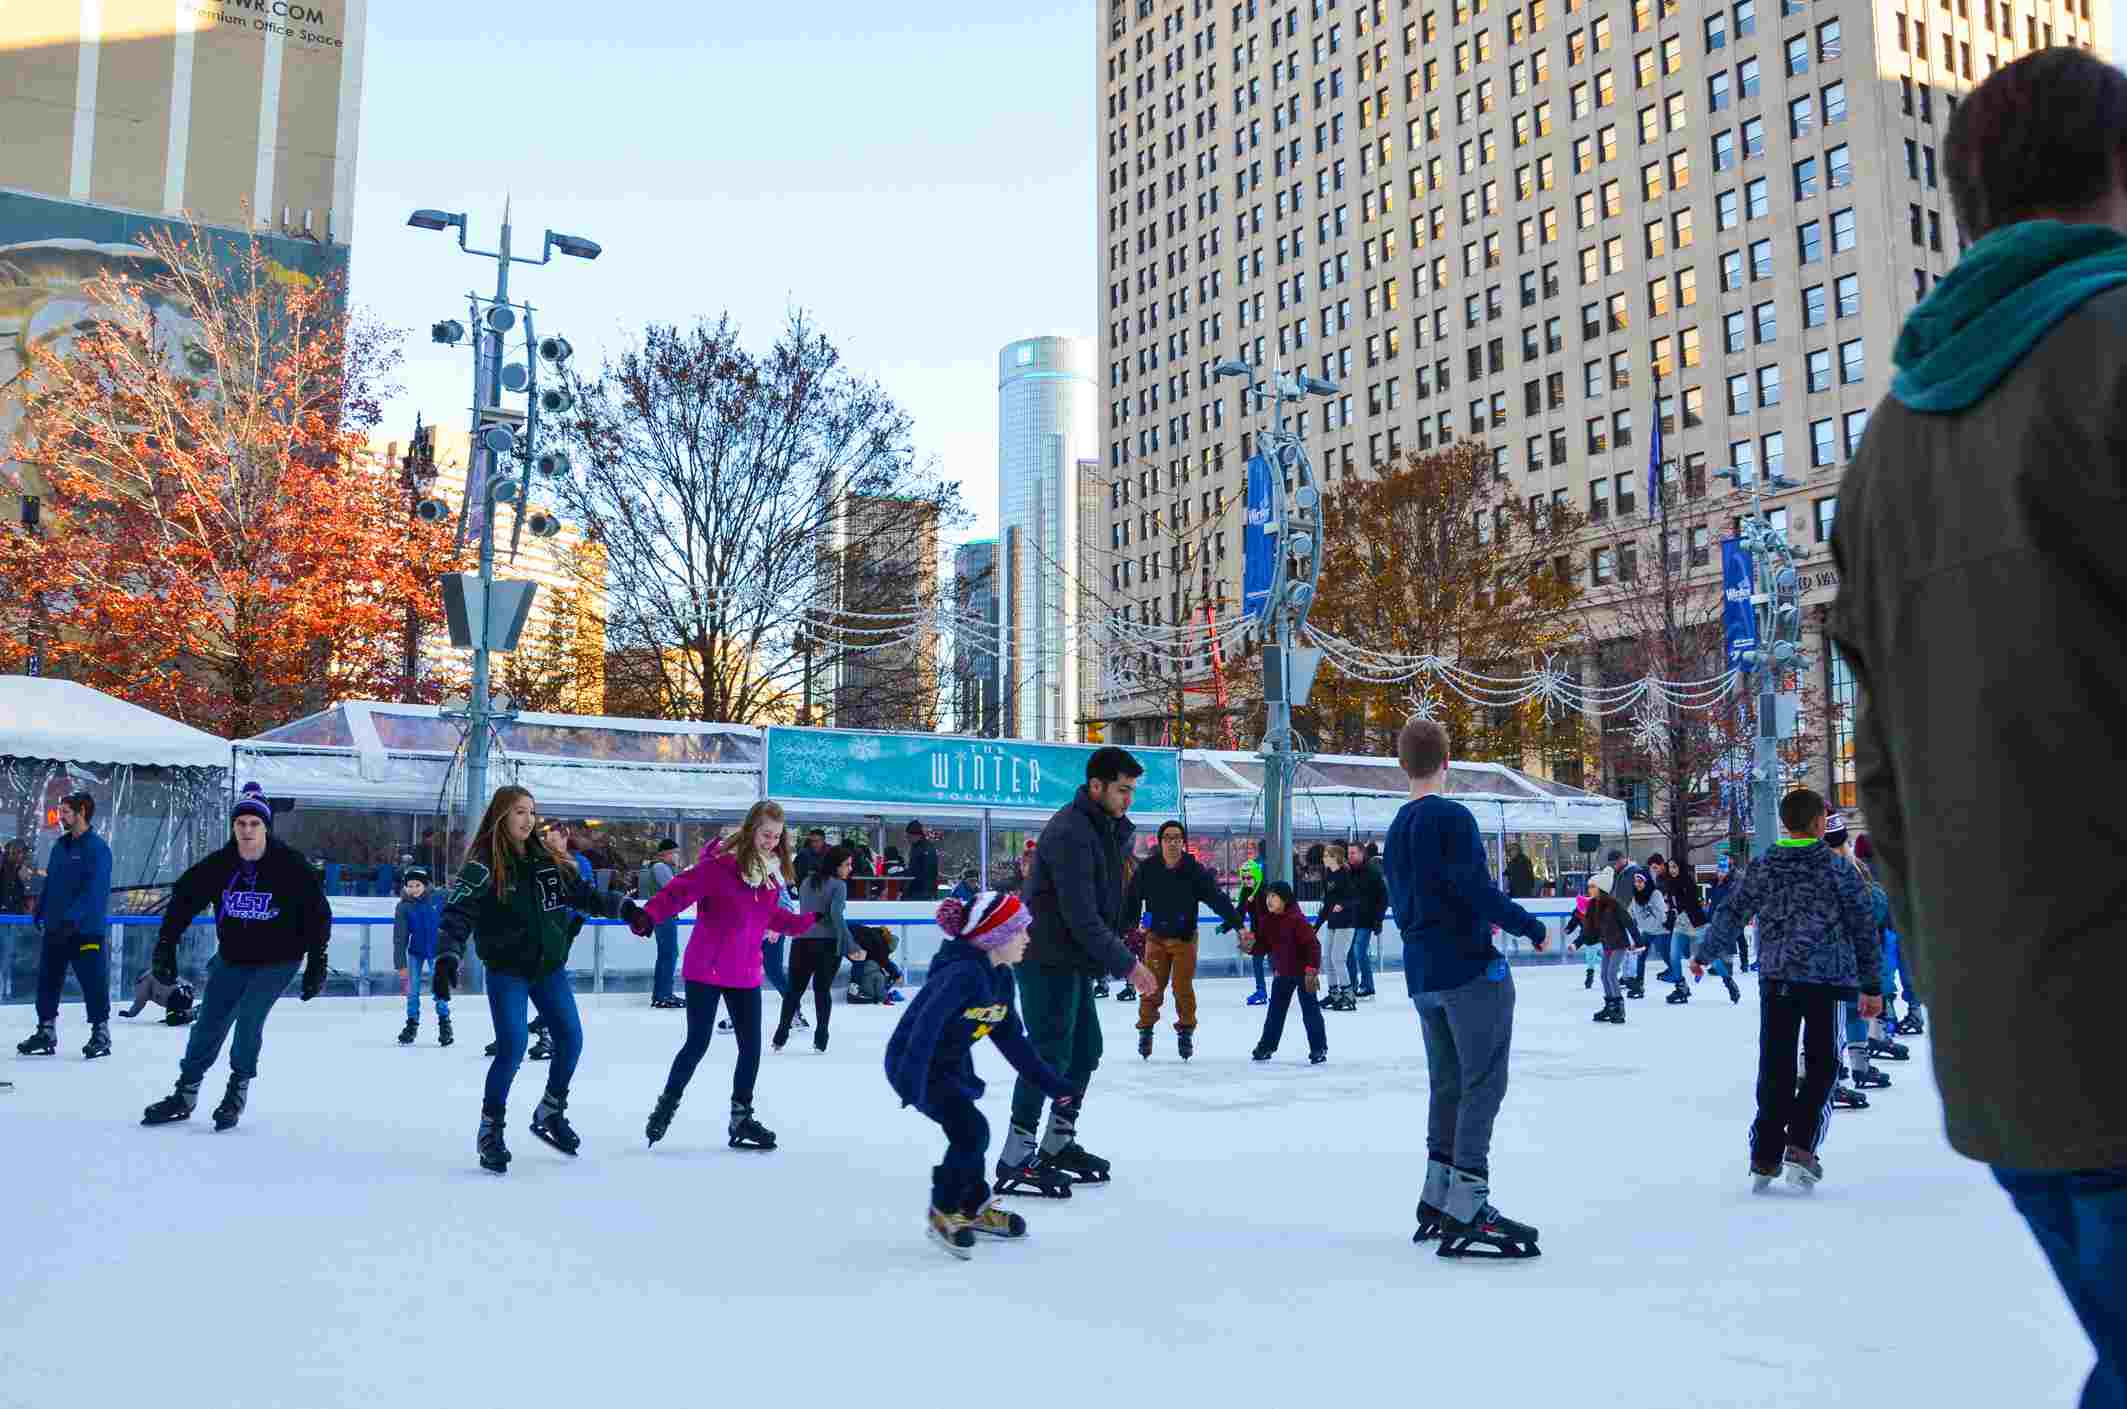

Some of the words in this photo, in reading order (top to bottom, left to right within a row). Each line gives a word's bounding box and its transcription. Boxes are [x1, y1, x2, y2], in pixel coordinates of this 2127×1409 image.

[255, 19, 294, 37] Office
[299, 30, 344, 48] Space
[931, 751, 1040, 793] WINTER
